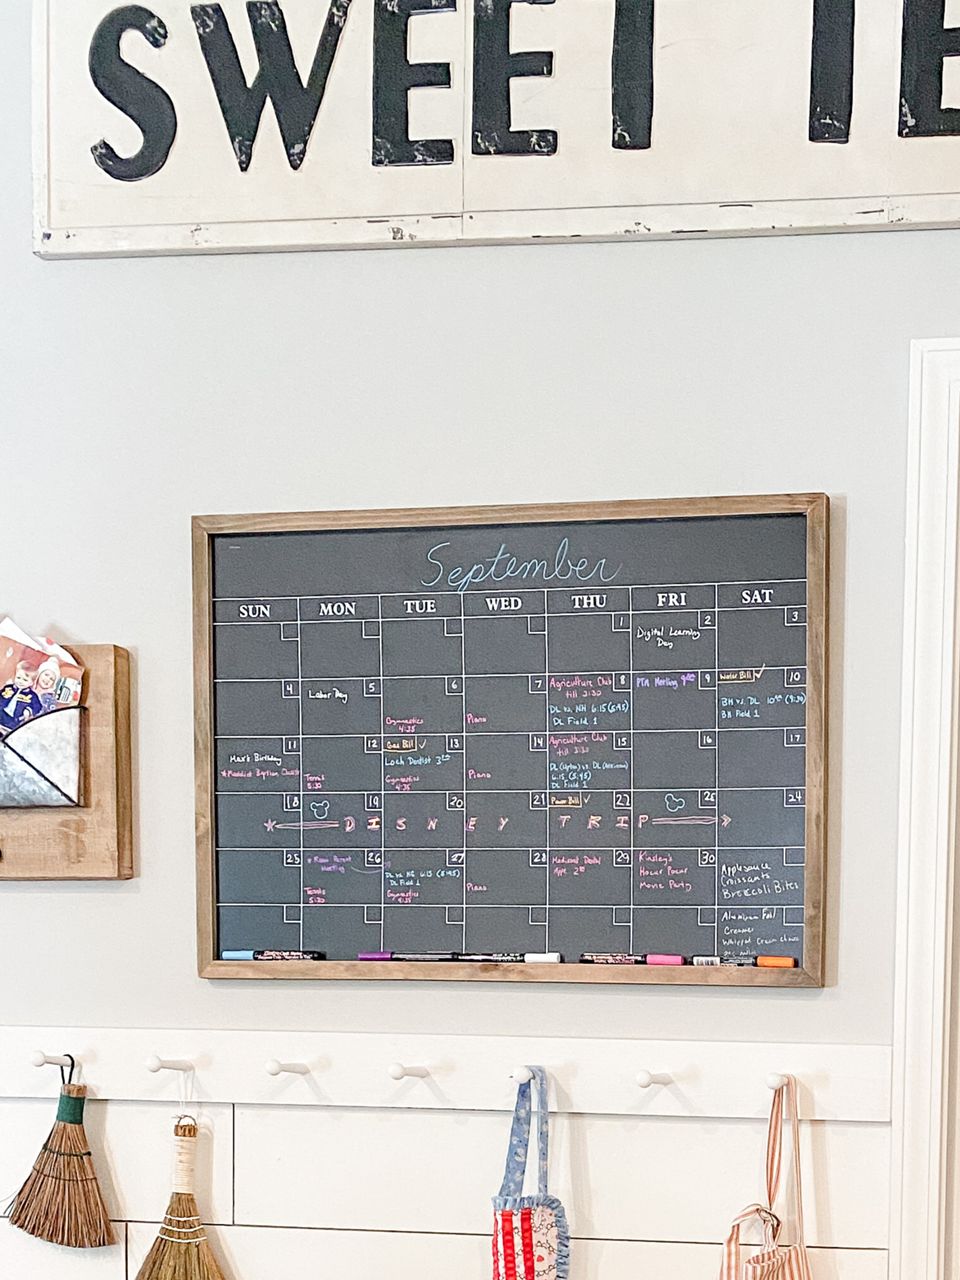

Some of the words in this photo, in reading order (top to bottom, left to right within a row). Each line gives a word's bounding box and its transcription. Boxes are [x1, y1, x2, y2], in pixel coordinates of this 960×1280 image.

[421, 538, 623, 592] September
[240, 604, 270, 618] SUN
[319, 602, 356, 616] MON
[404, 600, 437, 613] TUE
[485, 597, 522, 611] WED
[572, 595, 607, 608] THU
[657, 592, 687, 606] FRI
[742, 589, 774, 604] SAT
[637, 626, 663, 641] Digital
[669, 627, 701, 640] Learning
[657, 637, 674, 649] Day
[739, 671, 752, 680] Bill
[789, 672, 801, 682] 10
[549, 676, 593, 691] Agriculture
[308, 690, 331, 698] Labor
[333, 688, 348, 704] Day
[749, 697, 760, 705] DL
[385, 717, 424, 726] Gymnastics
[467, 713, 487, 724] Piano
[568, 716, 588, 725] Field
[367, 740, 378, 748] 12
[402, 739, 414, 748] Bill
[450, 739, 459, 748] 13
[533, 738, 543, 747] 14
[549, 734, 588, 748] Agriculture
[617, 738, 627, 746] 15
[703, 735, 712, 744] 16
[790, 734, 801, 743] 17
[468, 769, 491, 779] Piano
[369, 796, 379, 808] 19
[449, 796, 463, 808] 20
[533, 794, 545, 806] 21
[788, 791, 802, 802] 24
[286, 854, 300, 864] 25
[367, 853, 381, 864] 26
[615, 850, 630, 864] 29
[701, 851, 716, 864] 30
[721, 872, 770, 887] Croissants
[466, 882, 487, 892] Piano
[639, 880, 664, 889] Movie
[668, 879, 692, 892] Party
[773, 880, 799, 894] Bites
